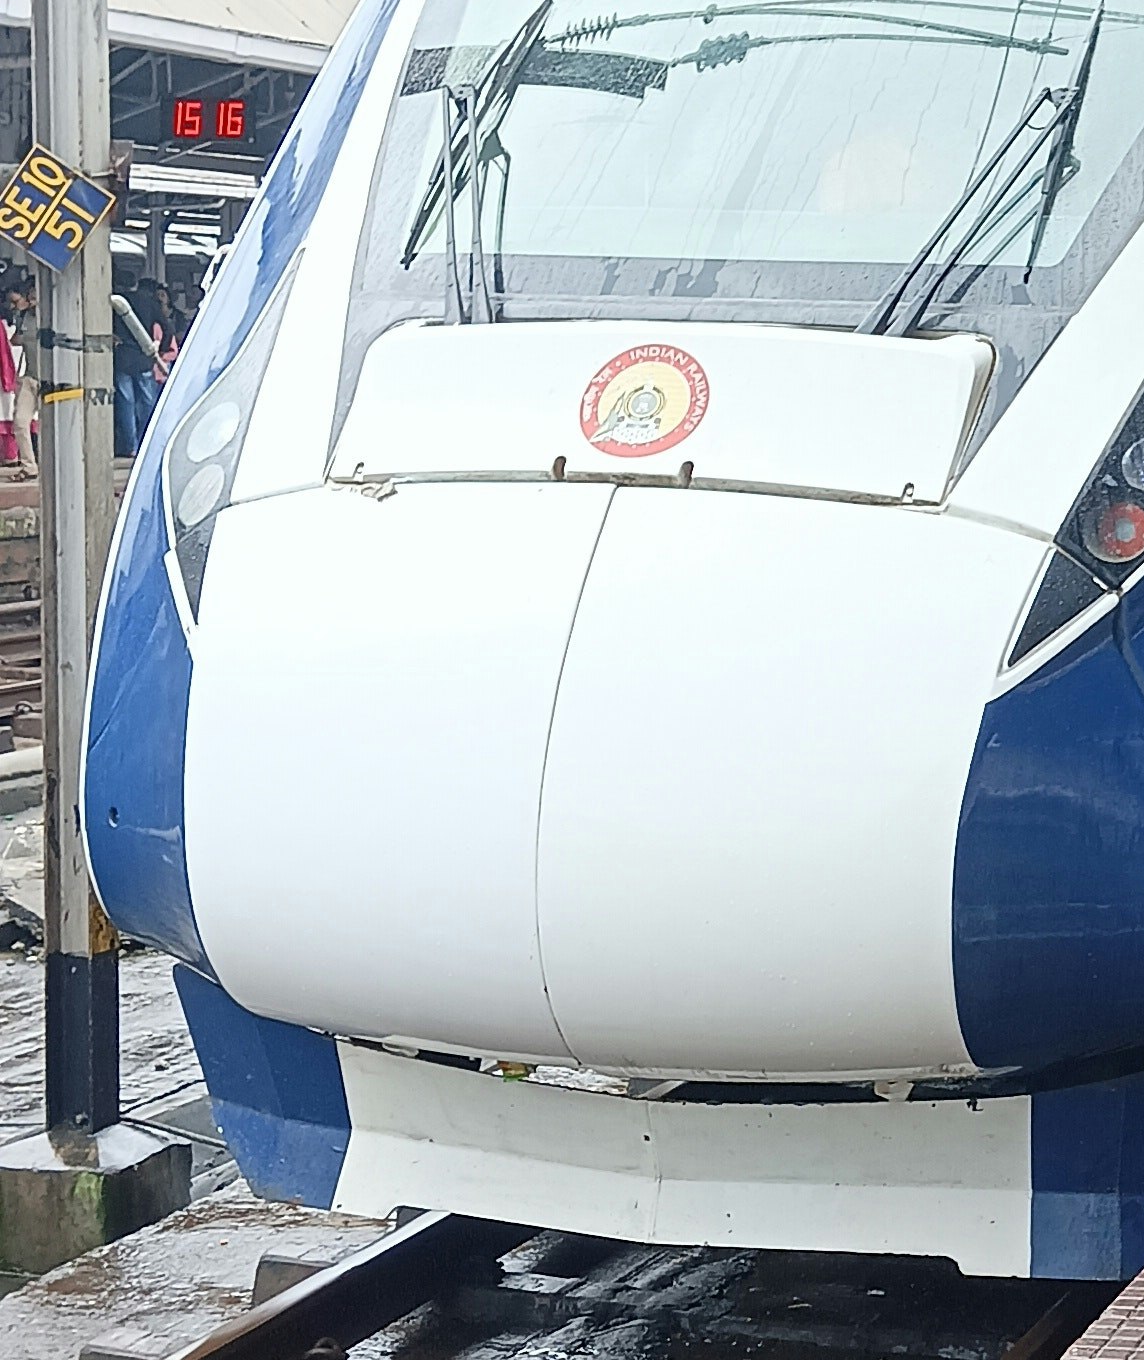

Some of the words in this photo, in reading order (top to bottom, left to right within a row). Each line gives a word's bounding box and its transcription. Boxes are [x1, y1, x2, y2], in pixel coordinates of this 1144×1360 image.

[176, 101, 201, 135] 15
[217, 101, 244, 135] 16
[44, 197, 95, 249] 51
[629, 346, 689, 366] INDIAN
[683, 362, 708, 431] RAILWAYS
